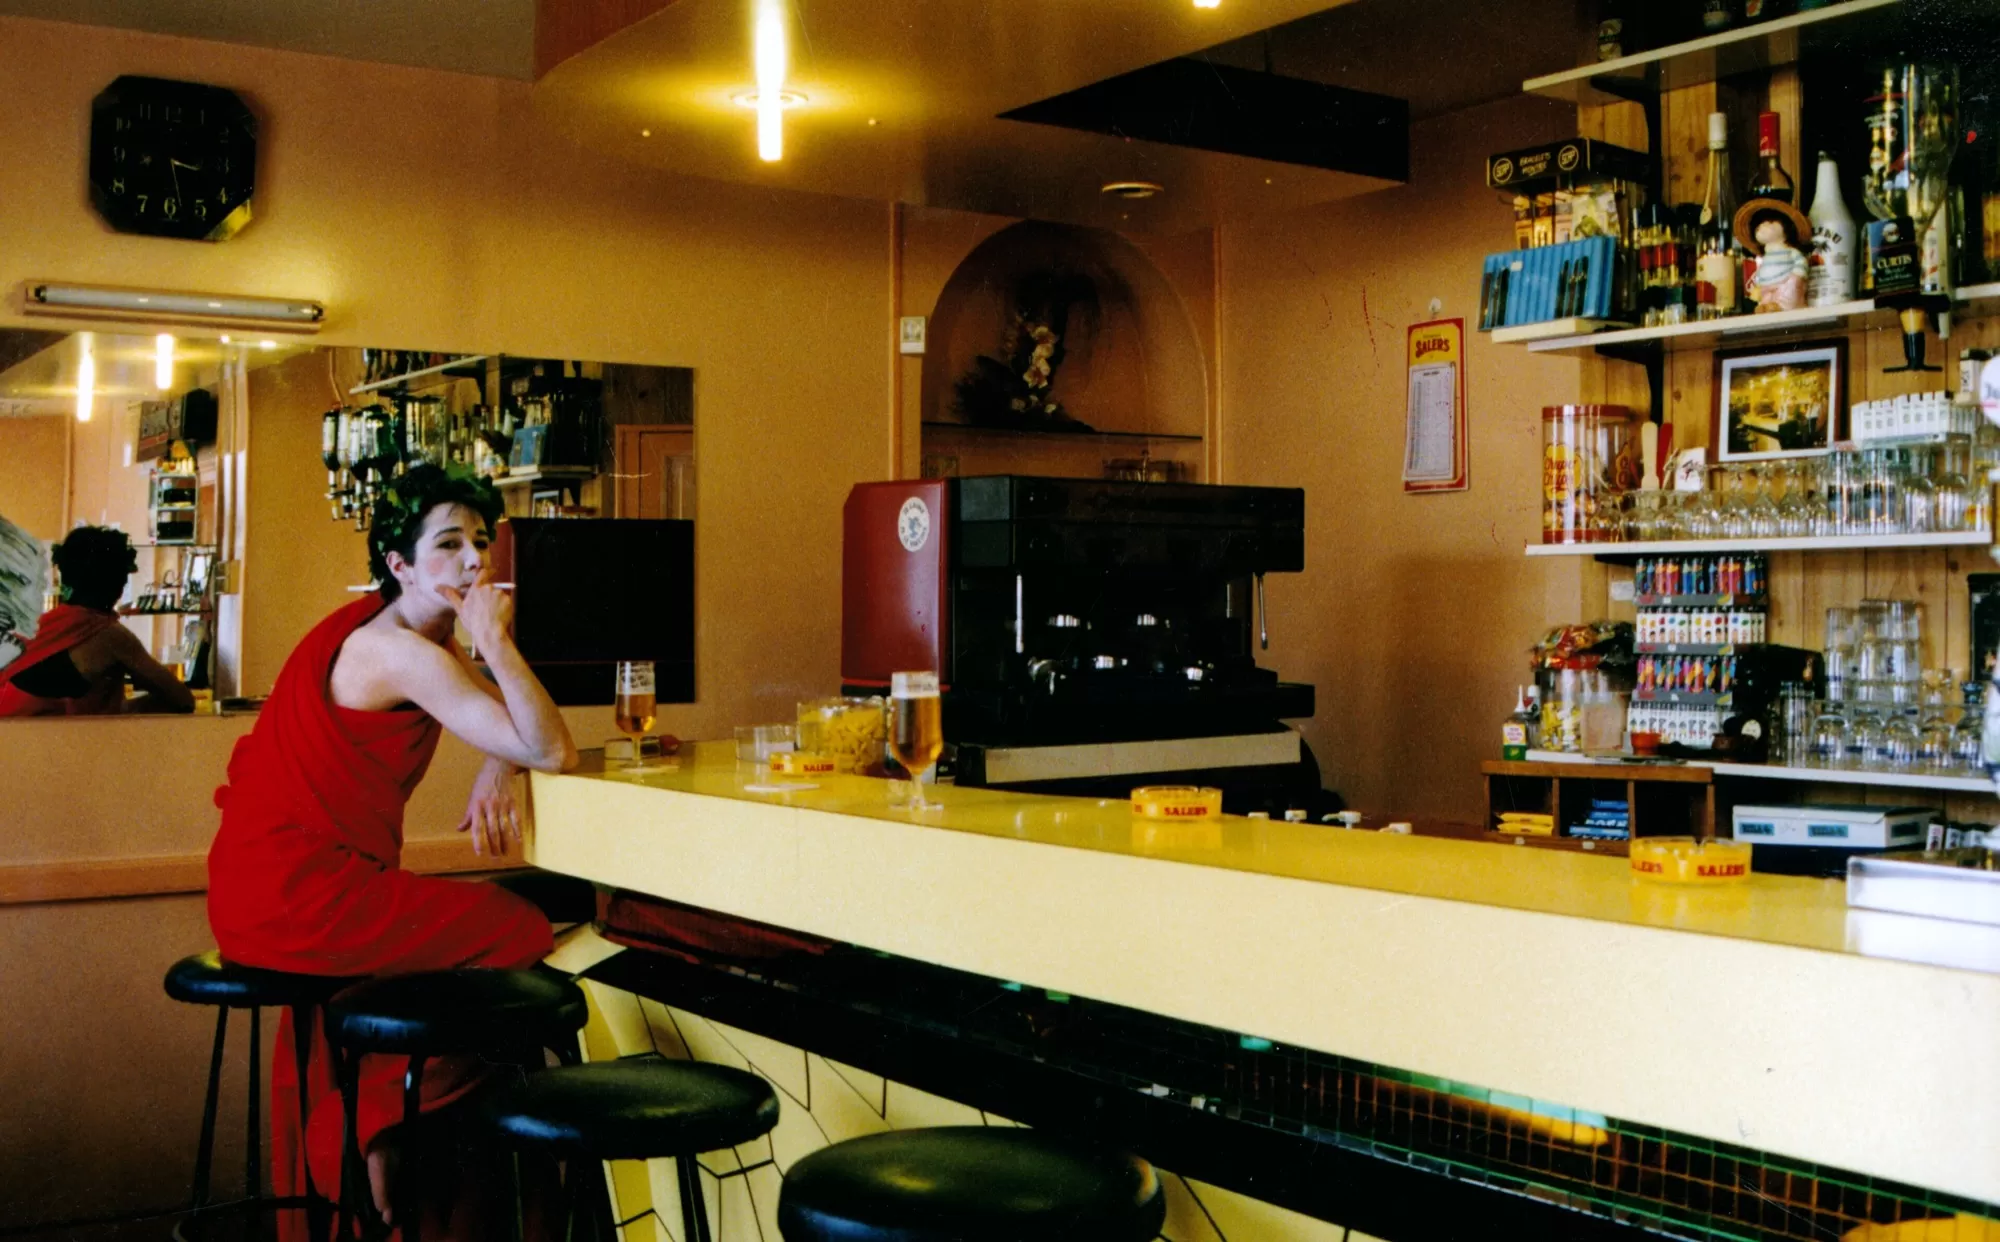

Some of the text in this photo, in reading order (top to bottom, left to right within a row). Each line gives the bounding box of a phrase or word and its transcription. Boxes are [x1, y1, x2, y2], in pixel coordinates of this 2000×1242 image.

[113, 146, 127, 163] 9
[112, 177, 126, 196] 8
[218, 187, 228, 204] 4
[136, 194, 149, 214] 7
[163, 197, 177, 219] 6
[194, 199, 208, 218] 5
[1415, 337, 1451, 359] SALERS
[803, 763, 834, 773] SALERS
[1164, 806, 1208, 817] SALERS
[1697, 864, 1745, 877] SALERS
